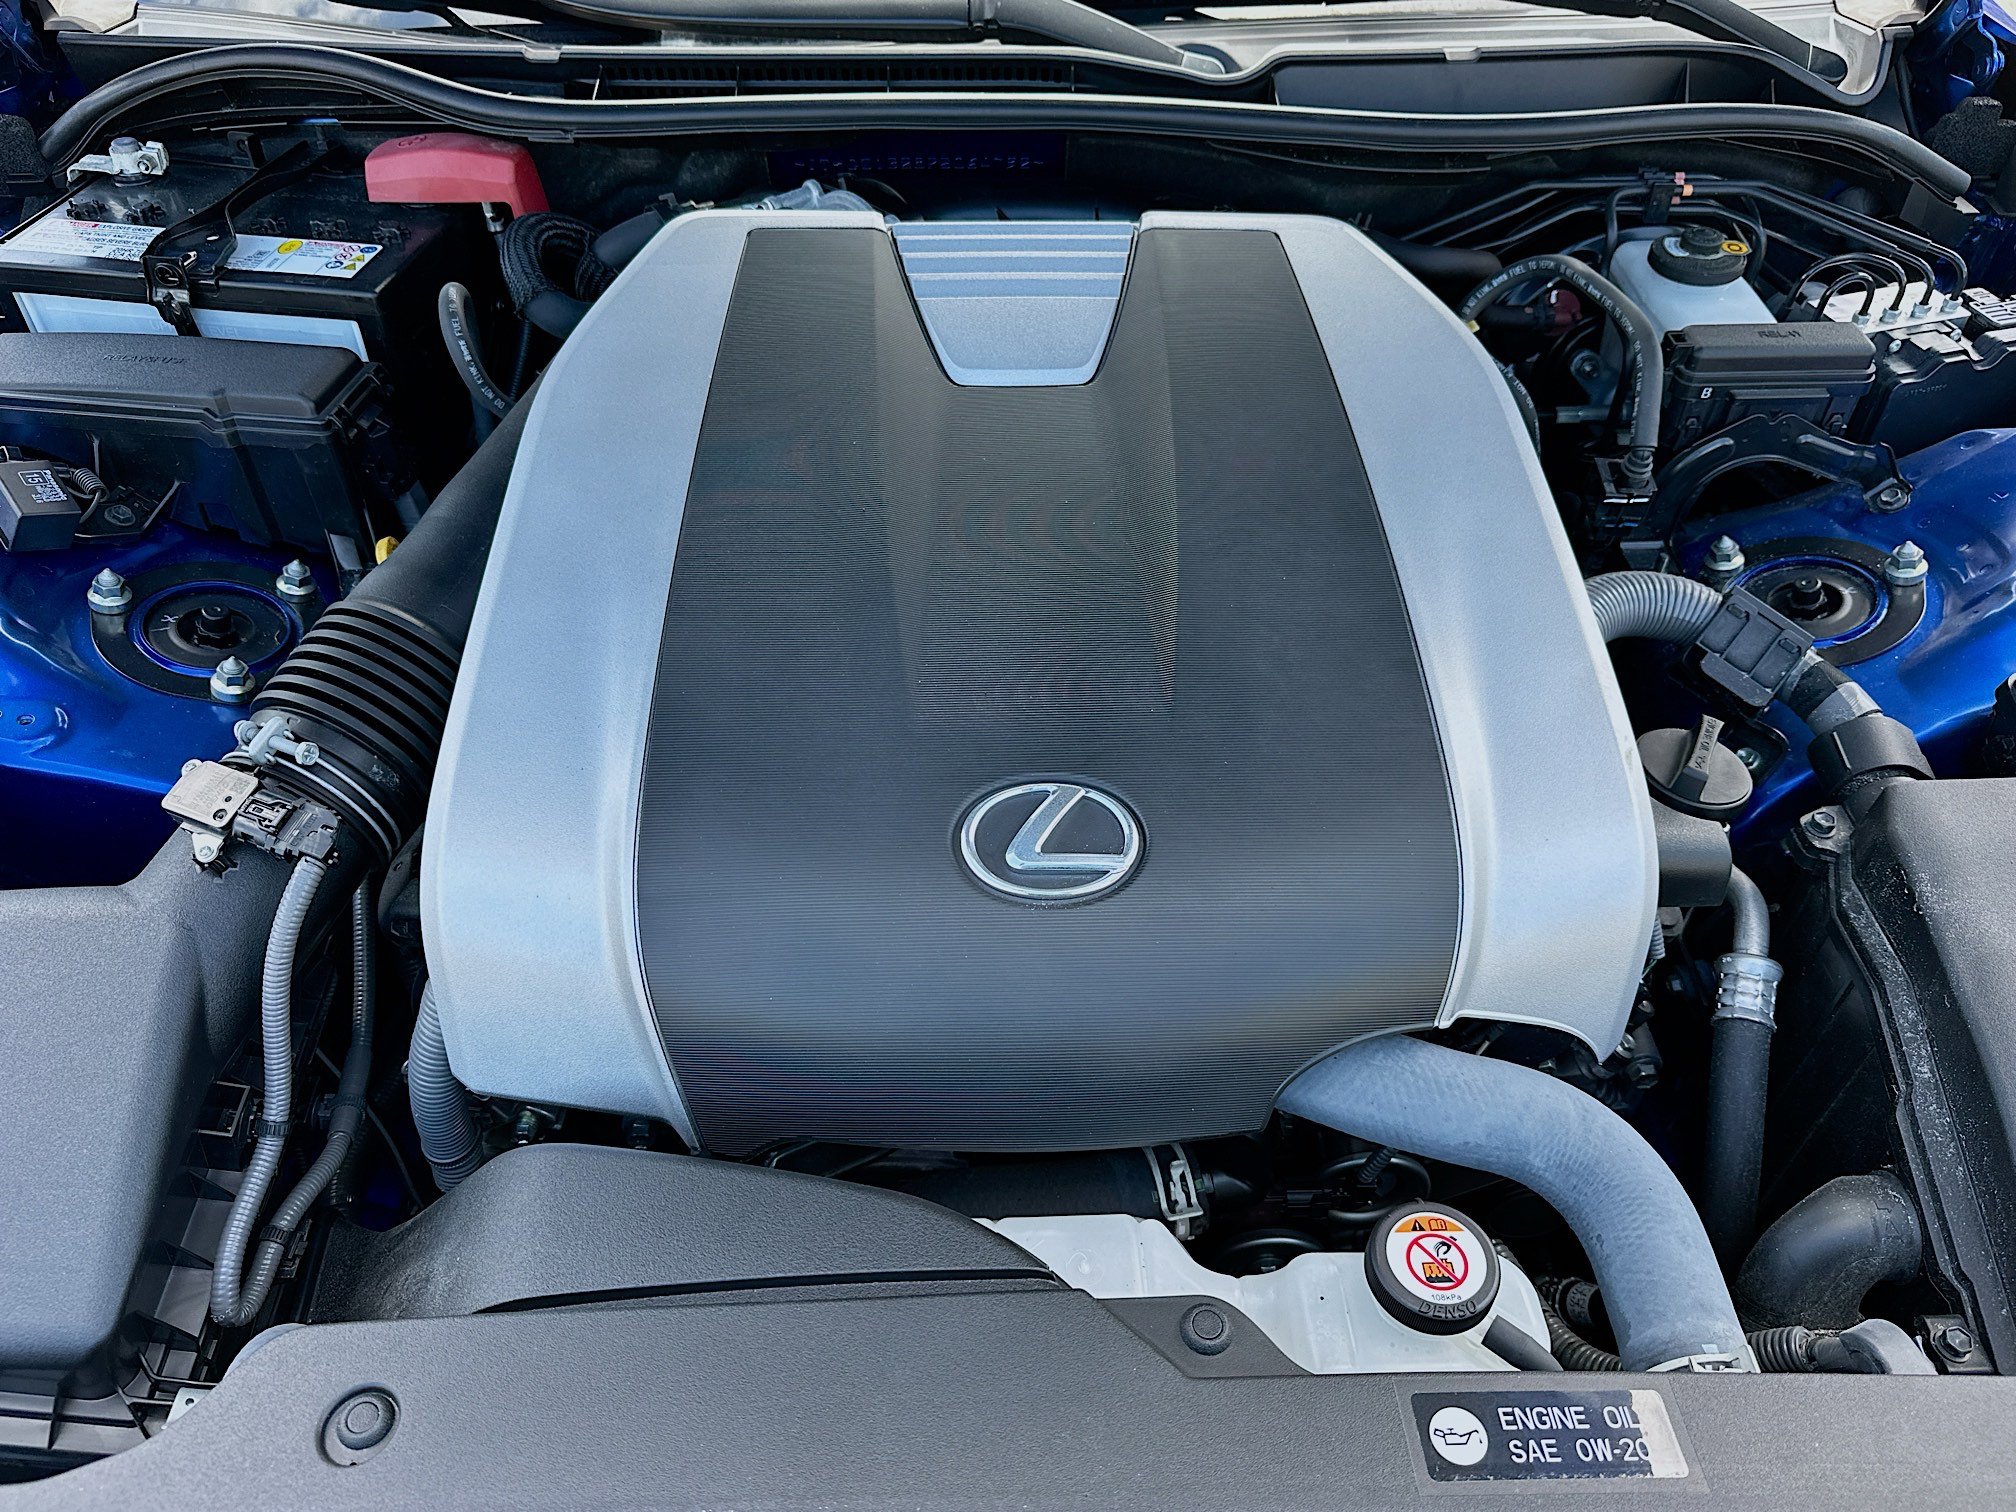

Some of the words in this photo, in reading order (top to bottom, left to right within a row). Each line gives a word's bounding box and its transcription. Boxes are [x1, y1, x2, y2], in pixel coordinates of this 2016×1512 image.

[451, 316, 464, 337] FUEL
[1758, 330, 1802, 339] RELAY
[481, 386, 496, 400] NOT
[1700, 386, 1713, 399] B
[494, 398, 505, 409] DO
[25, 473, 44, 484] 15
[1431, 1293, 1462, 1301] 108kPa
[1418, 1300, 1477, 1318] DENSO
[1498, 1406, 1590, 1430] ENGINE
[1603, 1405, 1641, 1429] OIL
[1508, 1438, 1563, 1463] SAE
[1574, 1437, 1653, 1463] 0W-20
